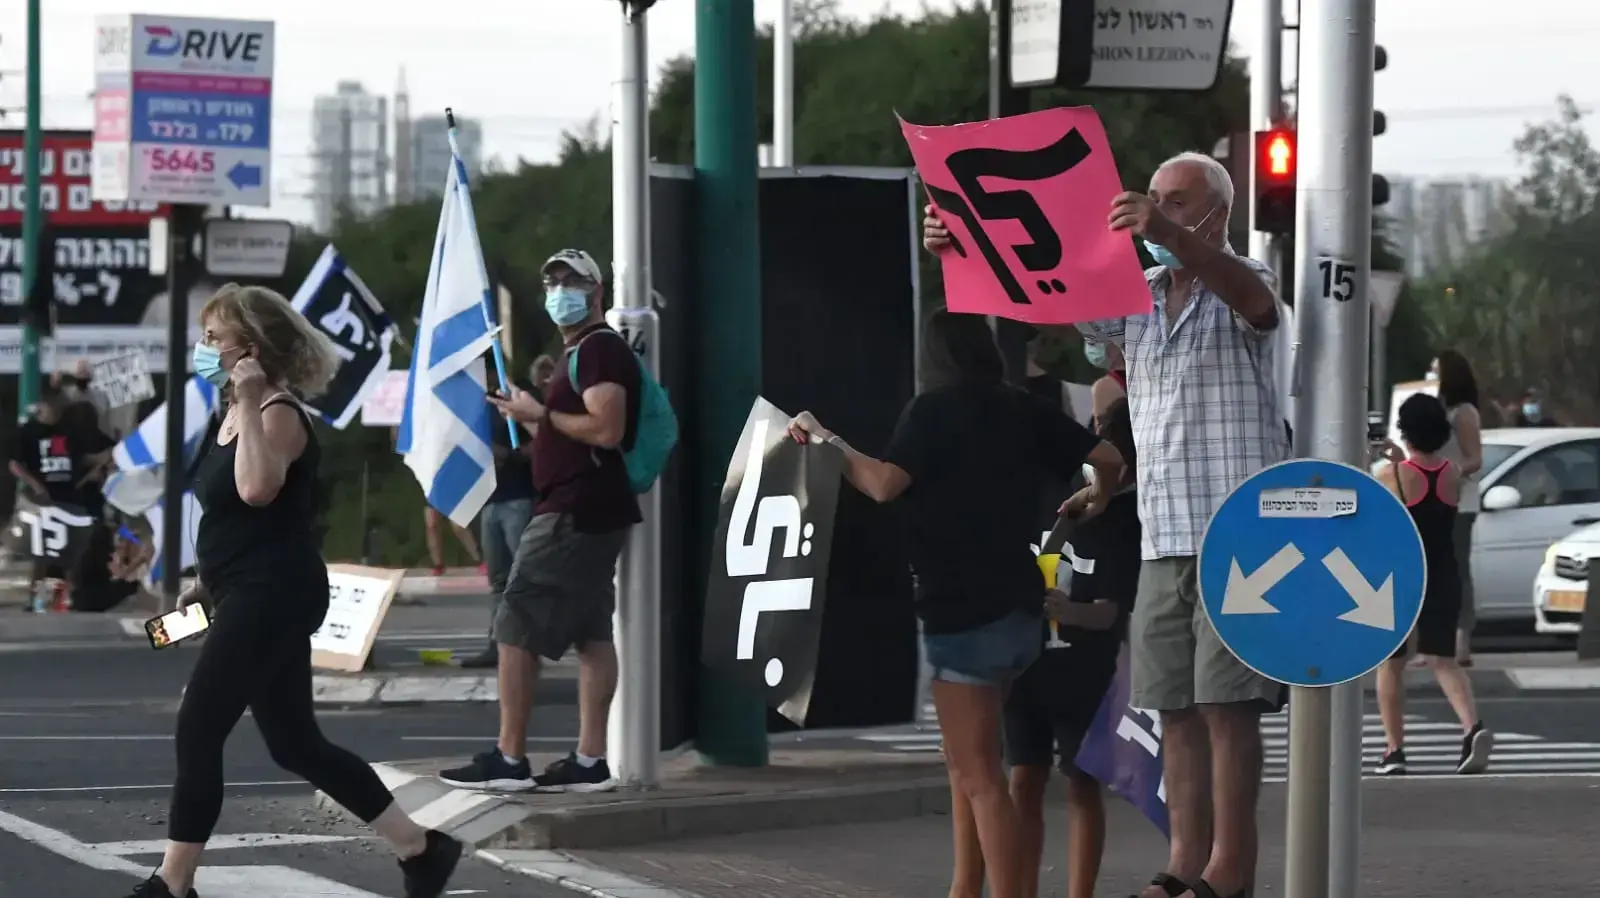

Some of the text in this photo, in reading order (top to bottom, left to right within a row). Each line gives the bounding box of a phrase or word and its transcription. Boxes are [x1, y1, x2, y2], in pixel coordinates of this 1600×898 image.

[1128, 9, 1187, 35] ראשון
[144, 25, 263, 62] DRIVE
[1136, 45, 1195, 62] LEZION
[1318, 261, 1356, 302] 15
[1335, 500, 1354, 511] שבת
